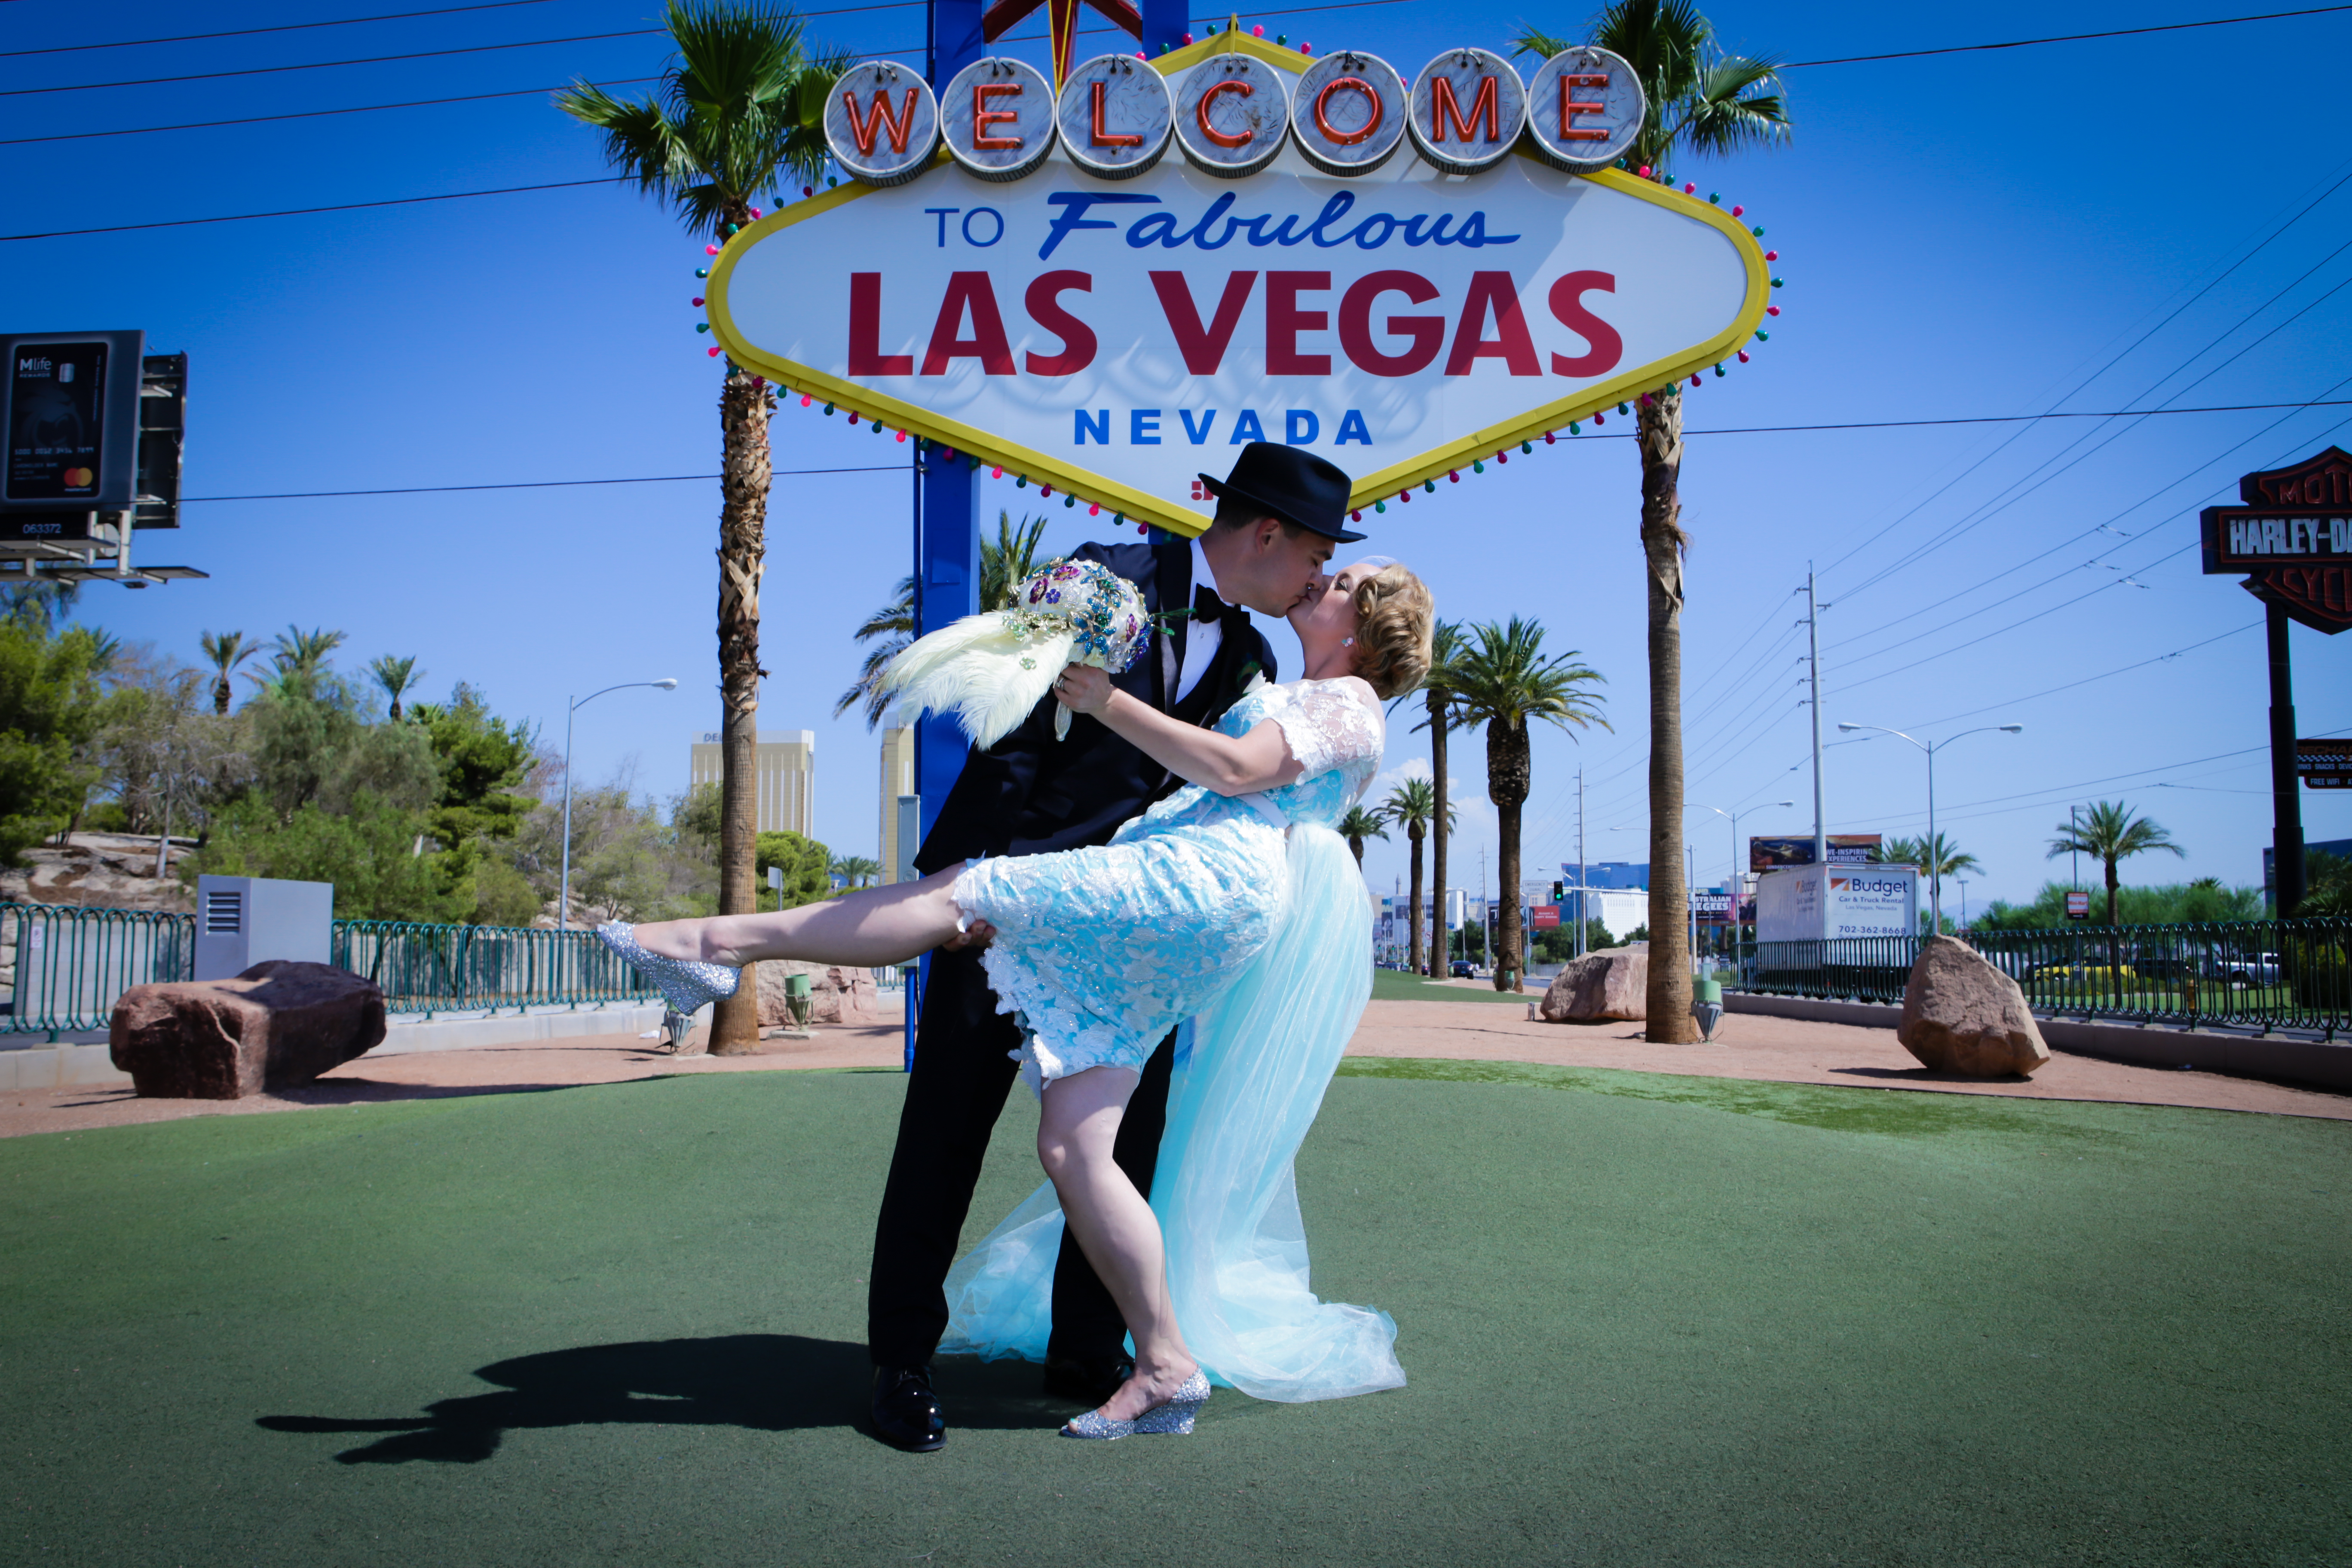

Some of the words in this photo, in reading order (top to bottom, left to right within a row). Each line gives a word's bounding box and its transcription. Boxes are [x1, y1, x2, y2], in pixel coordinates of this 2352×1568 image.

[843, 74, 1609, 157] WELCOME
[925, 207, 1004, 247] TO
[1038, 190, 1520, 260] Fabulous
[848, 270, 1097, 377] LAS
[1148, 270, 1623, 377] VEGAS
[1075, 409, 1372, 445] NEVADA
[2280, 463, 2352, 504] MOT
[23, 524, 61, 534] 063372
[1853, 879, 1908, 896] Budget
[1839, 925, 1906, 934] 702-362-8668
